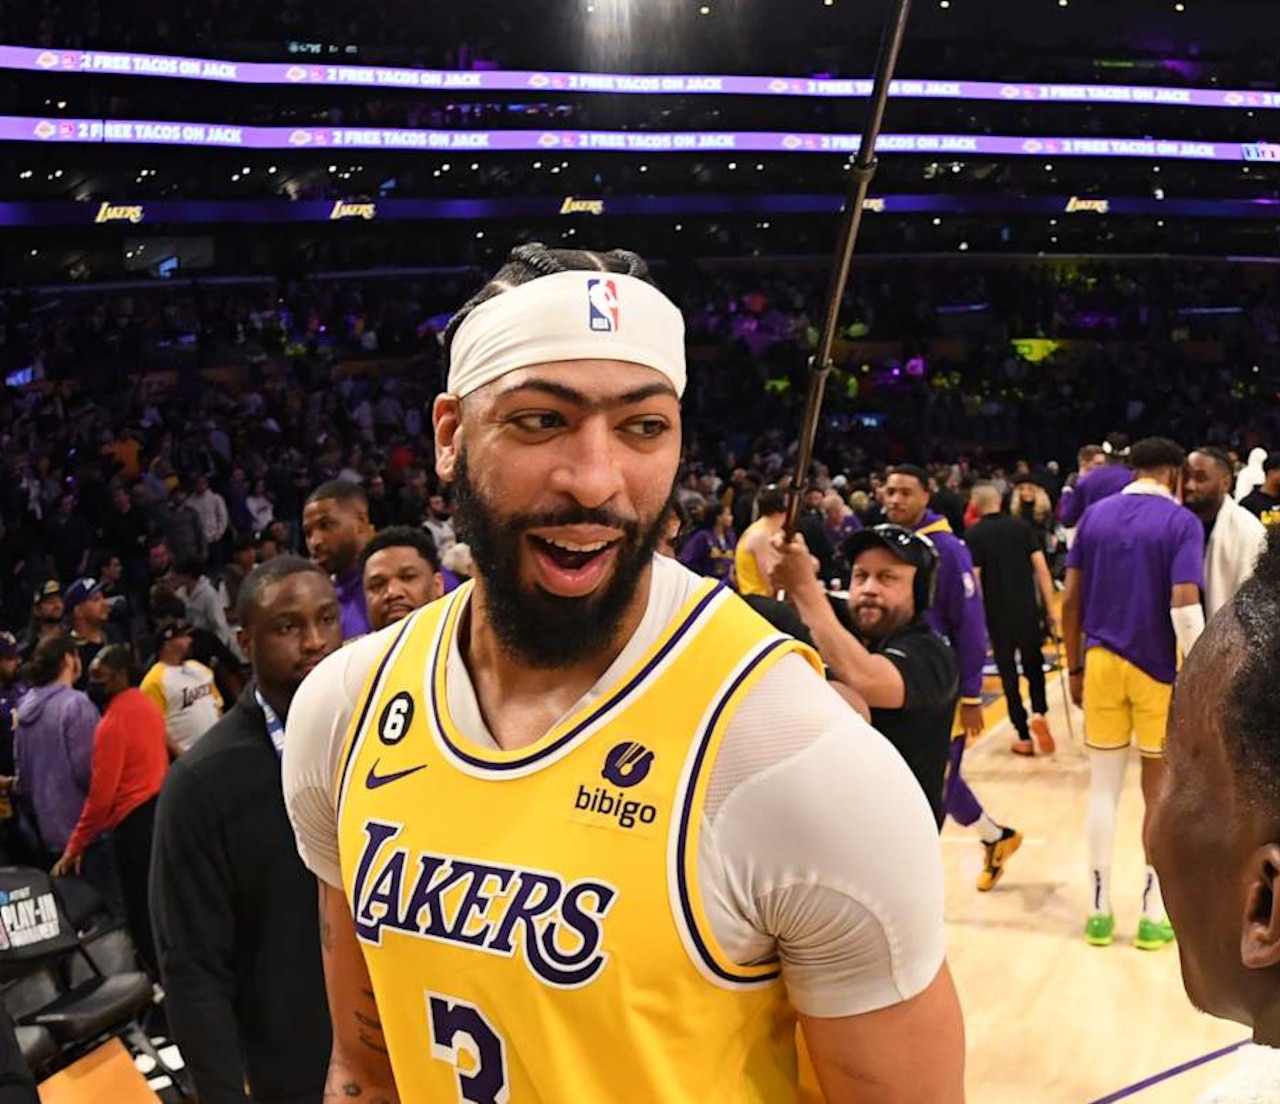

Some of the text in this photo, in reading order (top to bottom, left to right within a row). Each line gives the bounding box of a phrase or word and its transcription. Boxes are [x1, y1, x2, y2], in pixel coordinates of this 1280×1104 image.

[382, 698, 409, 741] 6
[574, 785, 657, 828] bibigo
[353, 817, 620, 990] LAKERS
